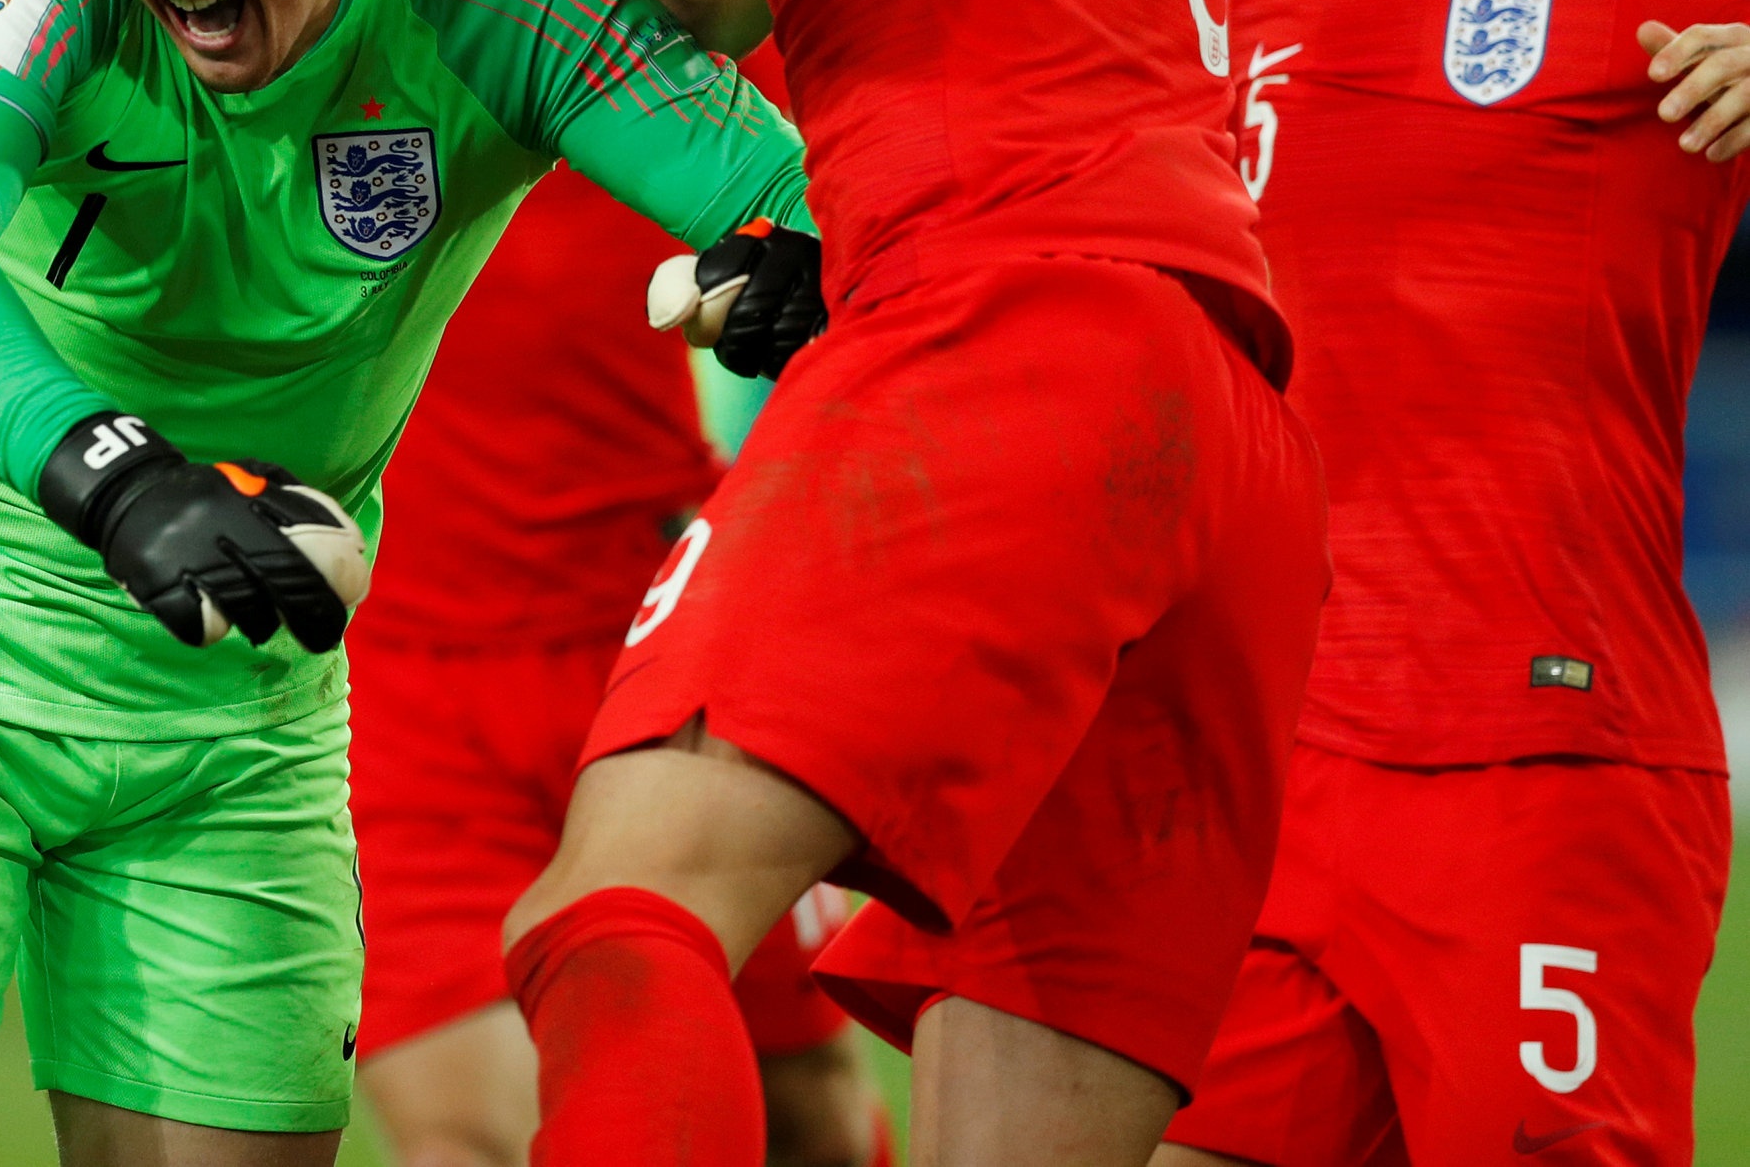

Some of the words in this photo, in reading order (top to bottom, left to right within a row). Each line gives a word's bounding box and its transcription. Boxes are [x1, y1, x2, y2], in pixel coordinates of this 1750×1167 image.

[1240, 73, 1290, 203] 5
[45, 192, 108, 291] 1
[360, 285, 368, 298] 3
[83, 416, 148, 470] JP
[624, 517, 713, 648] 9
[1519, 942, 1598, 1094] 5
